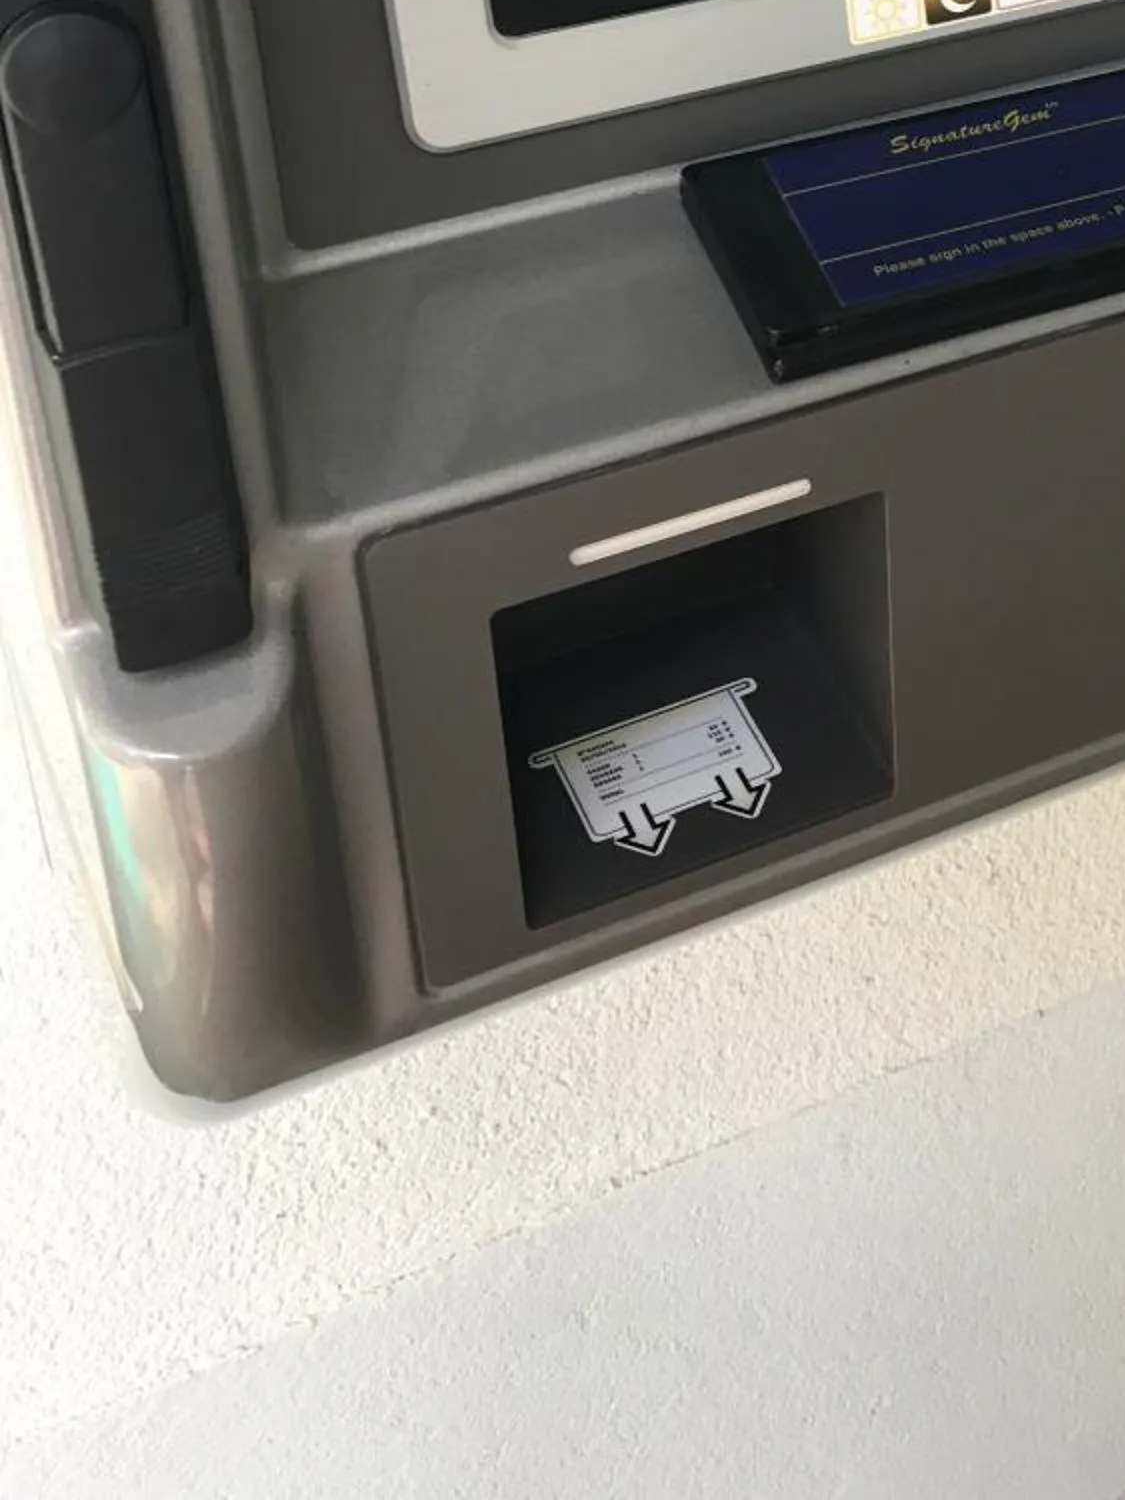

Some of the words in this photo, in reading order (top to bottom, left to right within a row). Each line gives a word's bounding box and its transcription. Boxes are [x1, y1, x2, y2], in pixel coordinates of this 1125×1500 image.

[873, 256, 925, 277] Please
[929, 247, 962, 261] sign
[964, 242, 981, 254] in
[981, 236, 1007, 250] the
[1010, 224, 1054, 243] space
